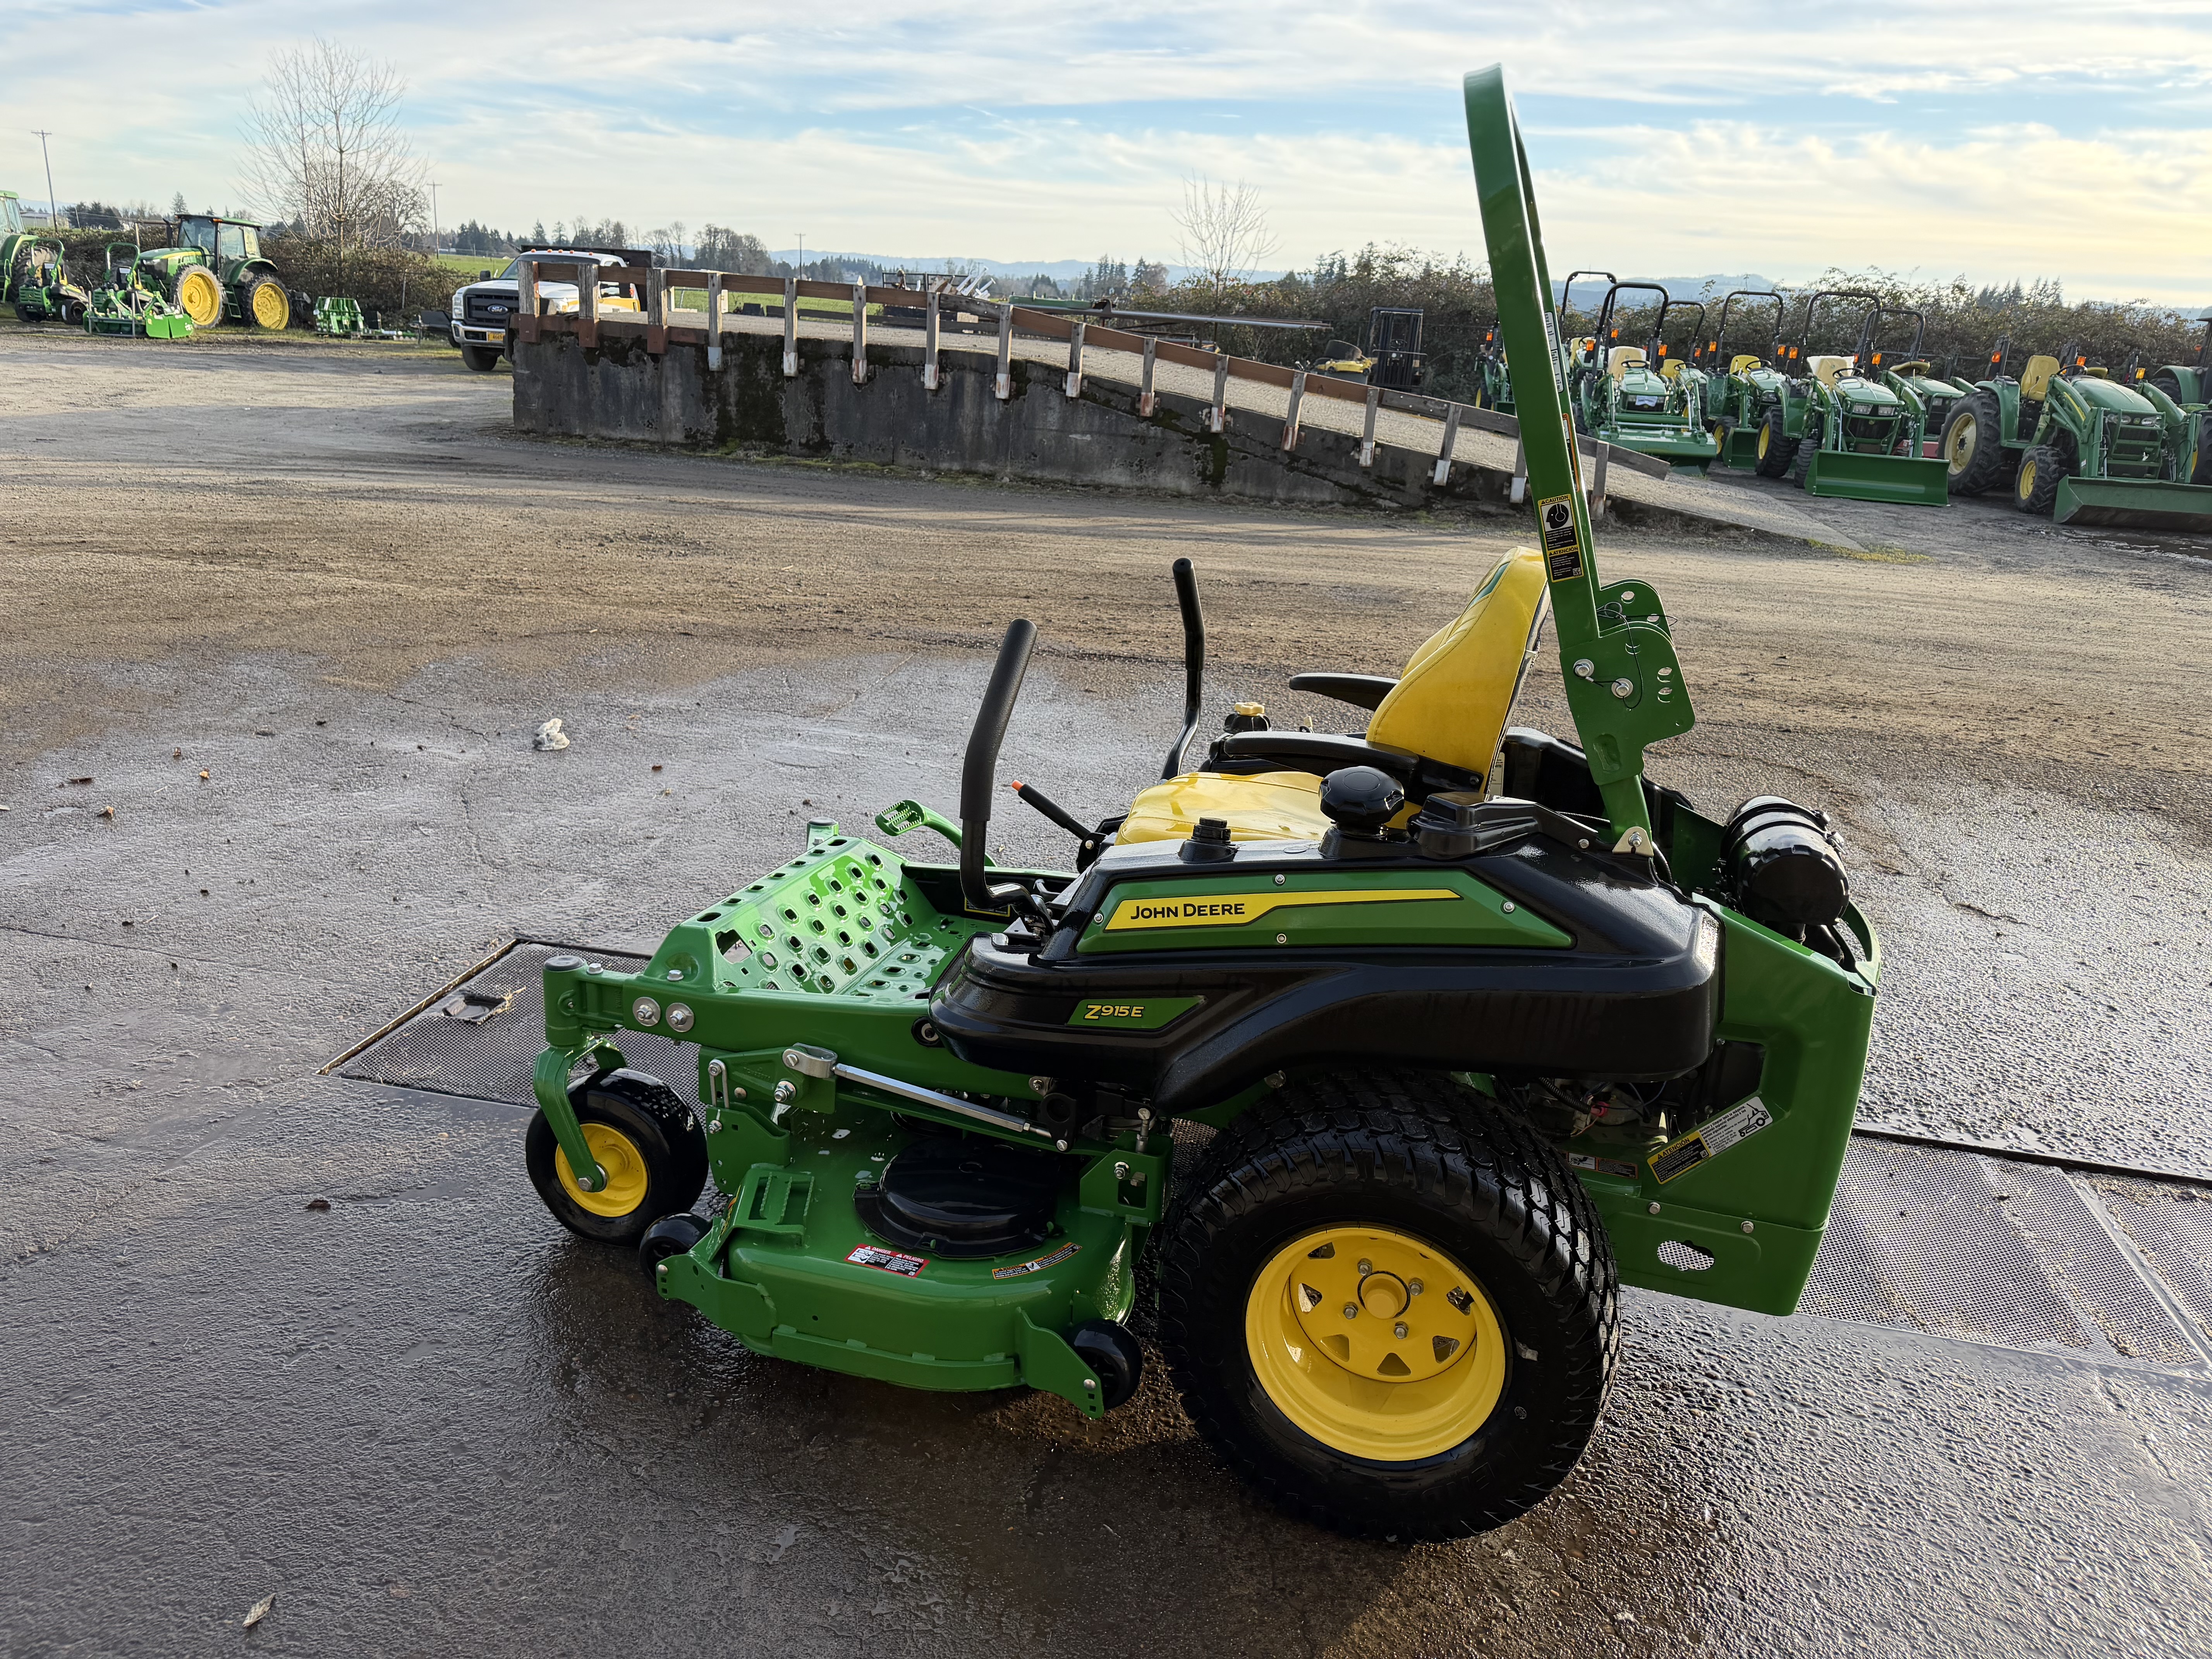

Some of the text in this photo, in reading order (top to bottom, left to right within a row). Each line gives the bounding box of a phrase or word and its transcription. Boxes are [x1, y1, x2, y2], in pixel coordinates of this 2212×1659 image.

[1545, 495, 1568, 503] CAUTION
[1553, 546, 1578, 555] ATENCIÓN
[1130, 903, 1245, 920] JOHN DEERE
[1084, 1005, 1144, 1019] Z915E
[1662, 1138, 1690, 1156] ATENCIÓN
[871, 1246, 891, 1254] DANGER
[903, 1254, 924, 1262] PELIGRO
